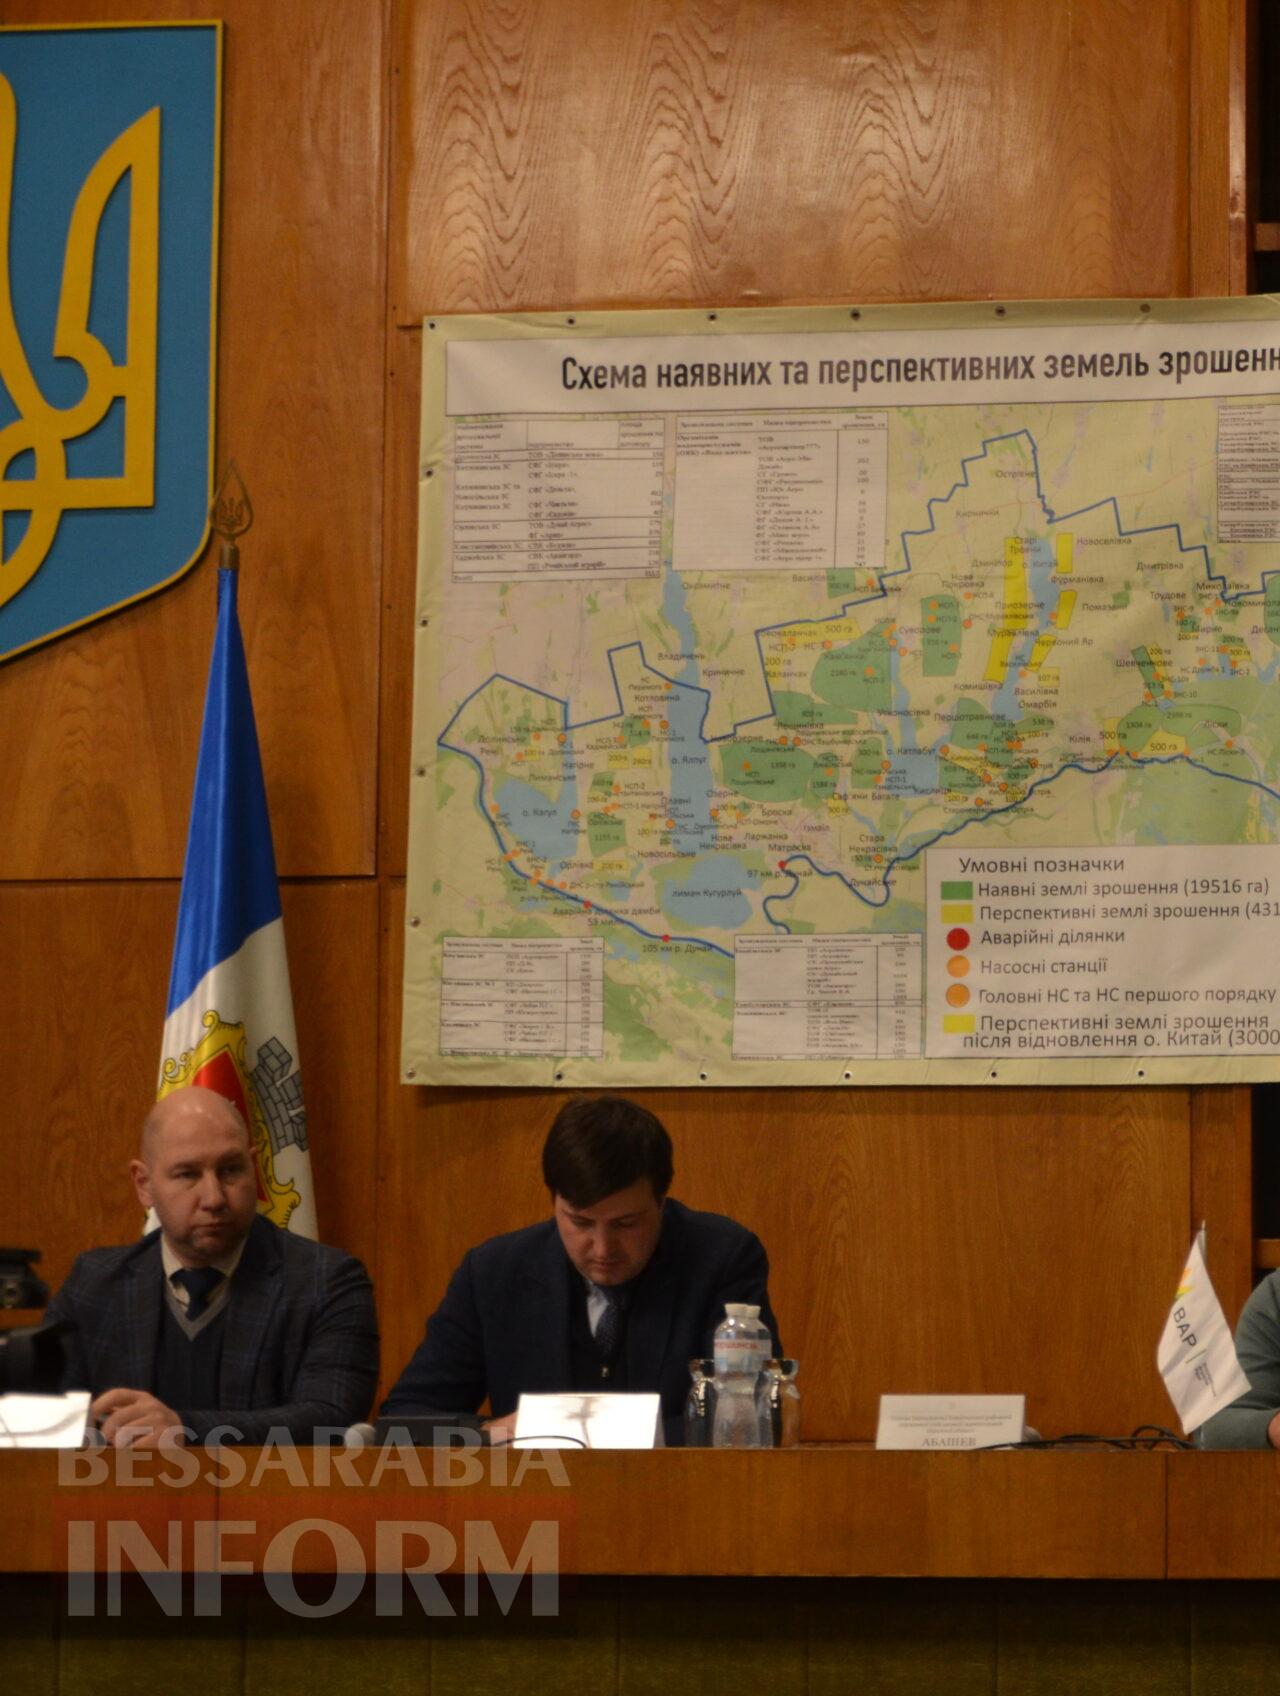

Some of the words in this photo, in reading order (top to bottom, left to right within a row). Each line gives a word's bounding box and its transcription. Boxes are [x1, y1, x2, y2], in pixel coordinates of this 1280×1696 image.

[562, 356, 647, 390] Схема
[657, 359, 772, 388] наявних
[780, 360, 808, 385] та
[819, 354, 1035, 392] перспективних
[1044, 351, 1150, 379] земель
[1150, 743, 1168, 752] 500
[958, 857, 1027, 874] Умовні
[1034, 857, 1125, 874] позначки
[978, 882, 1036, 898] Наявні
[1041, 881, 1088, 897] землі
[1093, 882, 1179, 899] зрошення
[1184, 878, 1242, 897] (19516
[1247, 877, 1270, 895] га)
[979, 905, 1096, 924] Перспективні
[1101, 903, 1148, 919] землі
[1153, 905, 1240, 920] зрошення
[981, 929, 1054, 948] Аварійні
[1058, 930, 1126, 946] ділянки
[980, 959, 1046, 975] Насосні
[1051, 958, 1109, 977] станції
[978, 989, 1042, 1004] Головні
[1047, 988, 1070, 1003] НС
[1073, 990, 1091, 1003] та
[1097, 987, 1120, 1002] НС
[1125, 989, 1200, 1005] першого
[1205, 988, 1277, 1004] порядку
[980, 1014, 1109, 1033] Перспективні
[1114, 1013, 1168, 1031] землі
[1173, 1014, 1269, 1031] зрошення
[963, 1033, 1012, 1049] після
[1018, 1032, 1138, 1050] відновлення
[1144, 1034, 1160, 1048] о.
[1167, 1030, 1222, 1047] Китай
